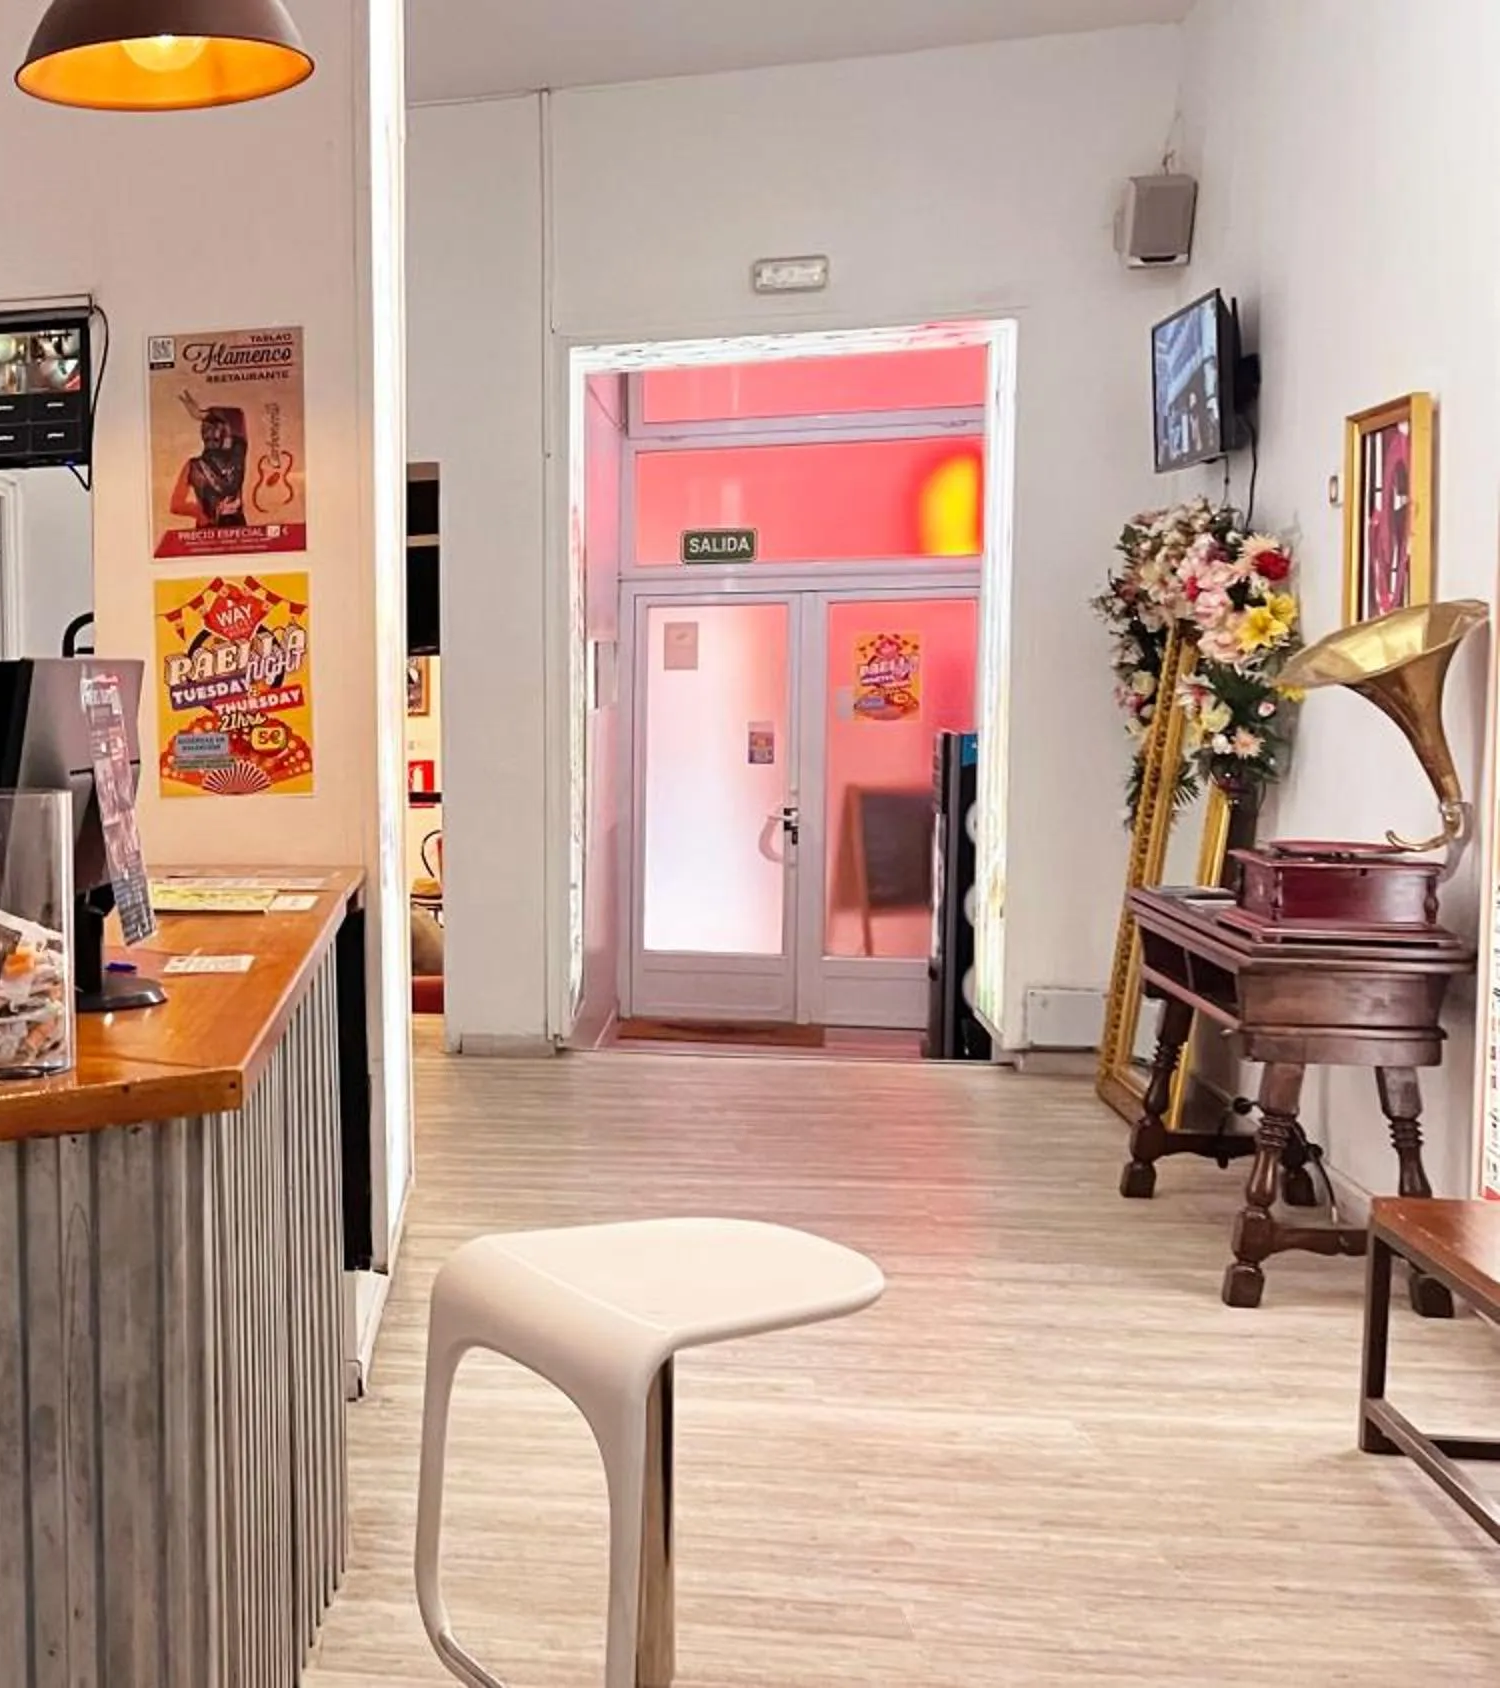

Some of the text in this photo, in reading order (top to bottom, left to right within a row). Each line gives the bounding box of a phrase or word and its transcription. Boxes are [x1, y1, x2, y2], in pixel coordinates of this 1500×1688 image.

[182, 342, 292, 374] Flamenco
[205, 371, 289, 384] RESTAURANTE
[217, 527, 264, 540] ESPECIAL
[688, 536, 750, 554] SALIDA
[215, 603, 252, 627] WAY
[165, 624, 306, 686] PAELLA
[172, 675, 250, 704] TUESDAY
[214, 690, 301, 714] THURSDAY
[257, 729, 281, 745] 5€
